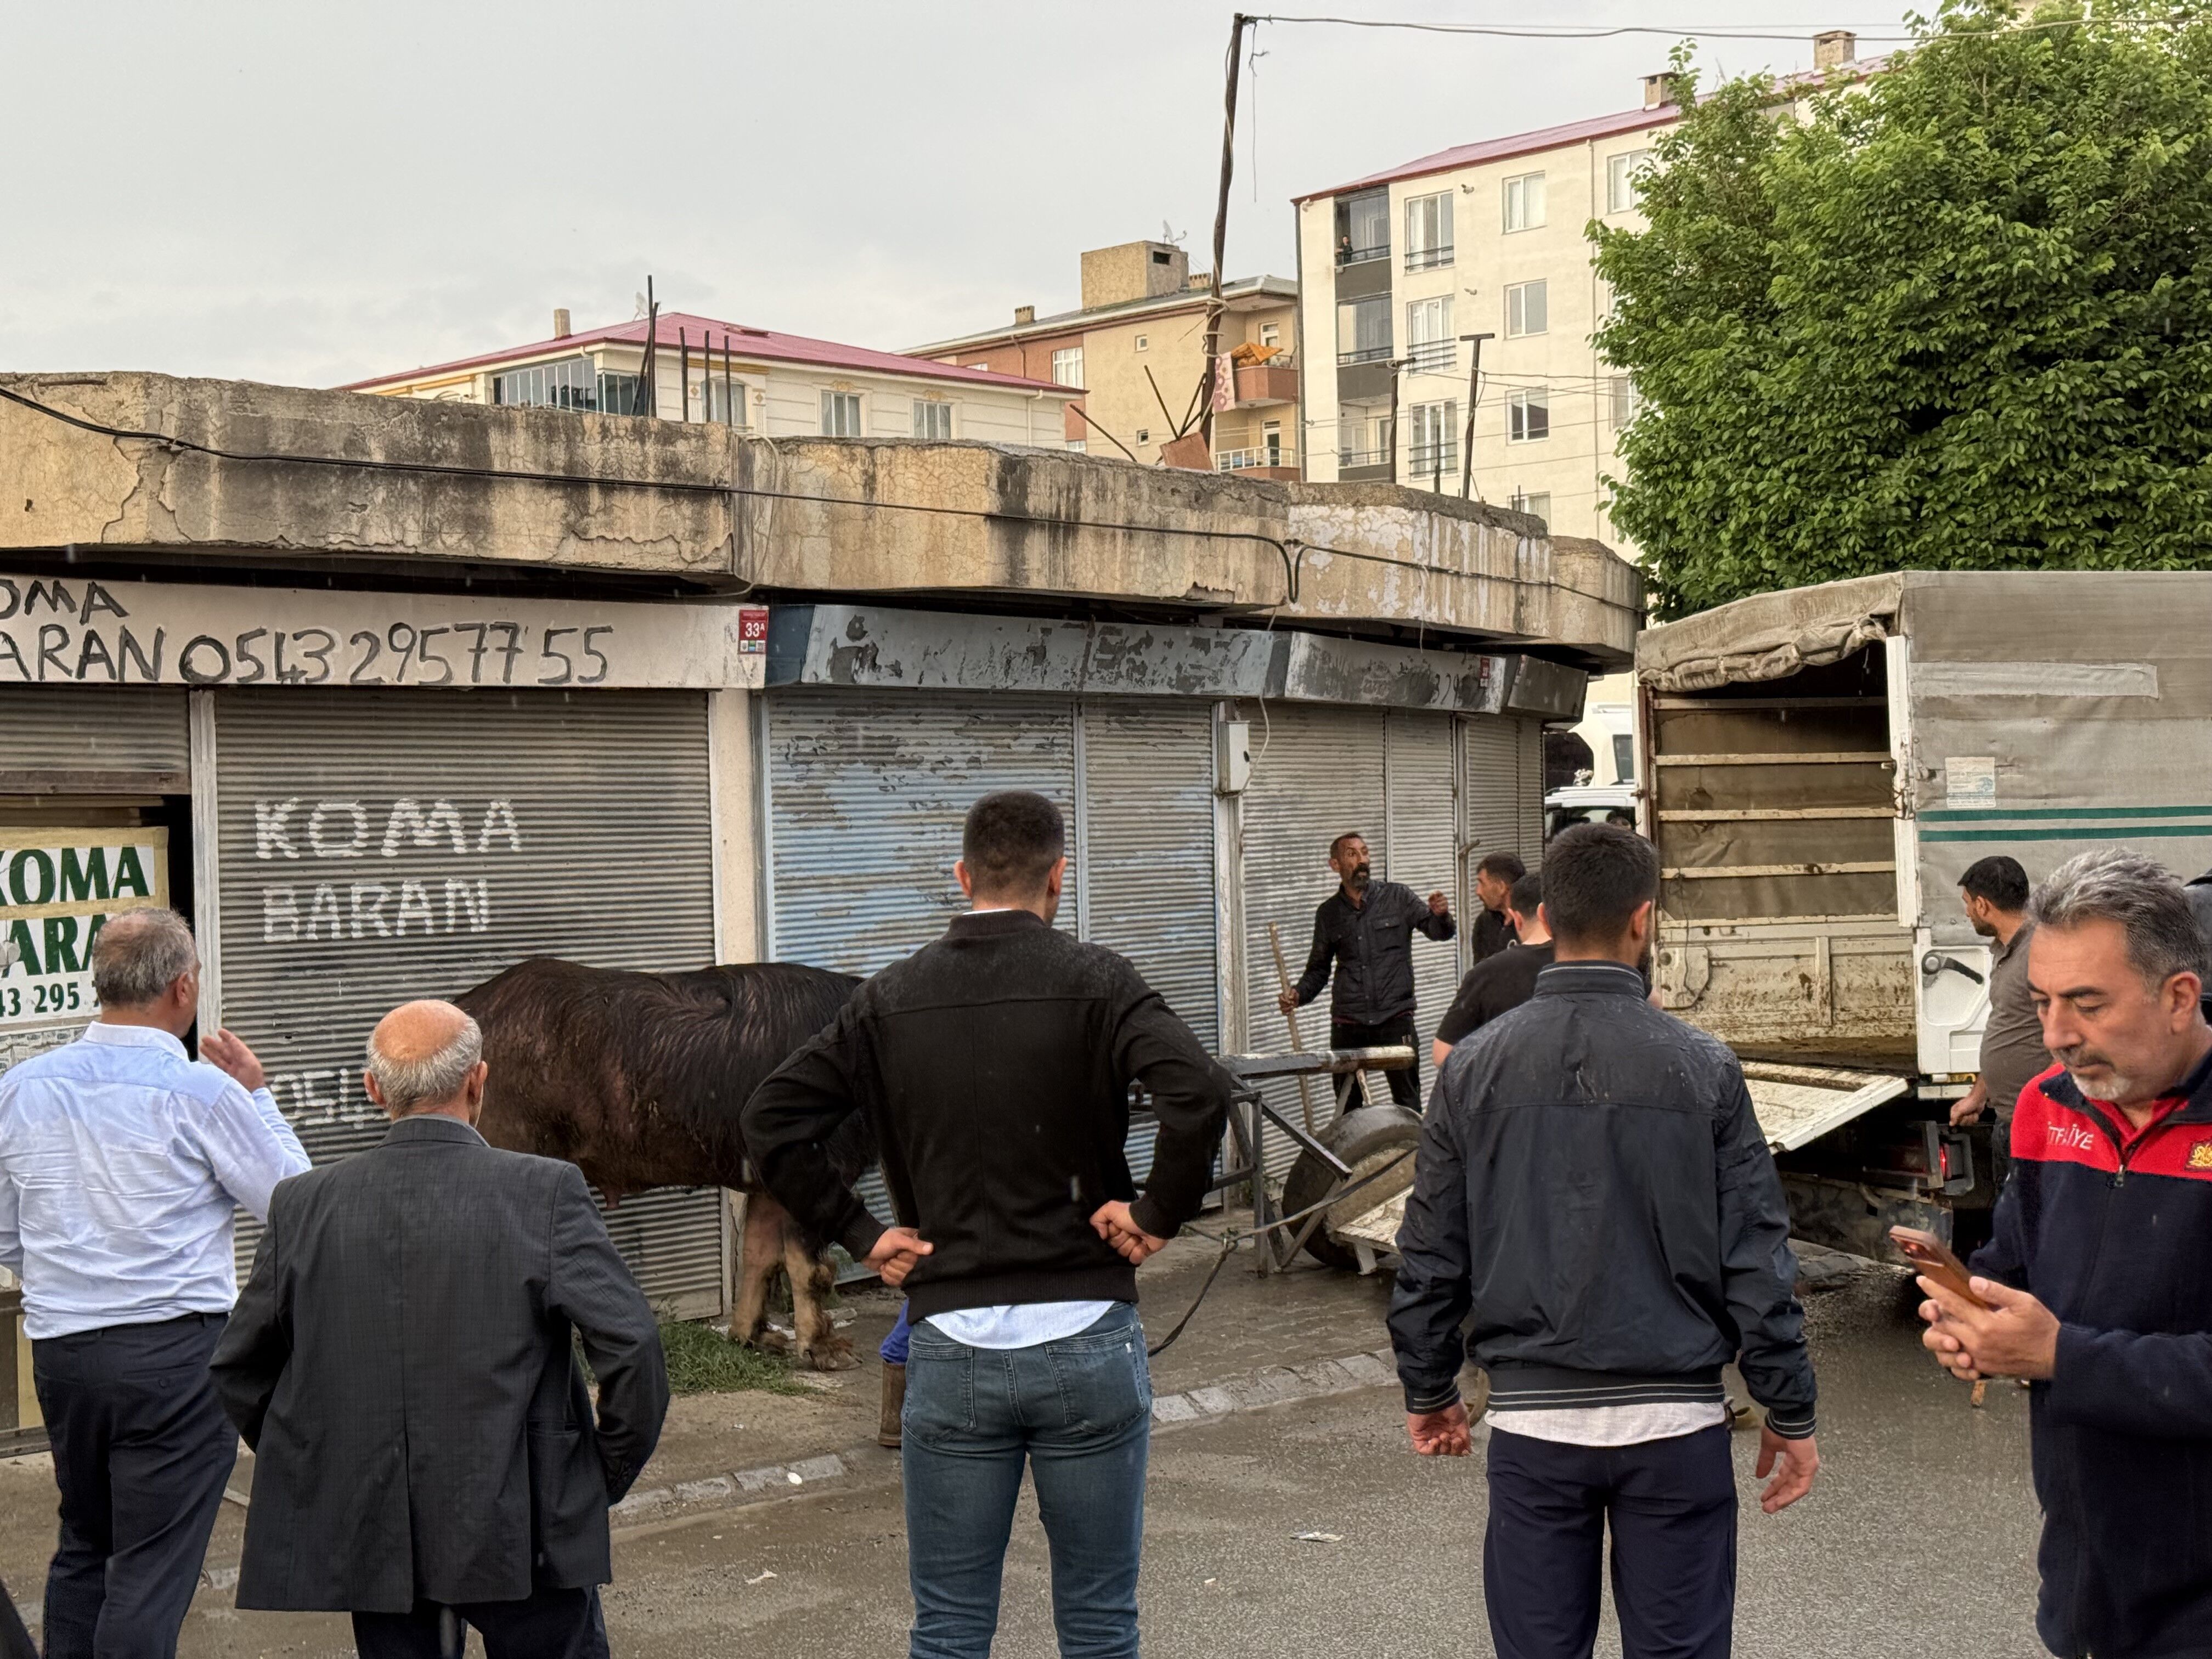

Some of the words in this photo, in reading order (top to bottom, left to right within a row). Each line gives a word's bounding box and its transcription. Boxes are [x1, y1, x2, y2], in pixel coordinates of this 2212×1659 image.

[254, 798, 522, 859] KOMA
[0, 847, 150, 906] OMA
[263, 879, 490, 942] BARAN
[33, 982, 80, 1014] 295
